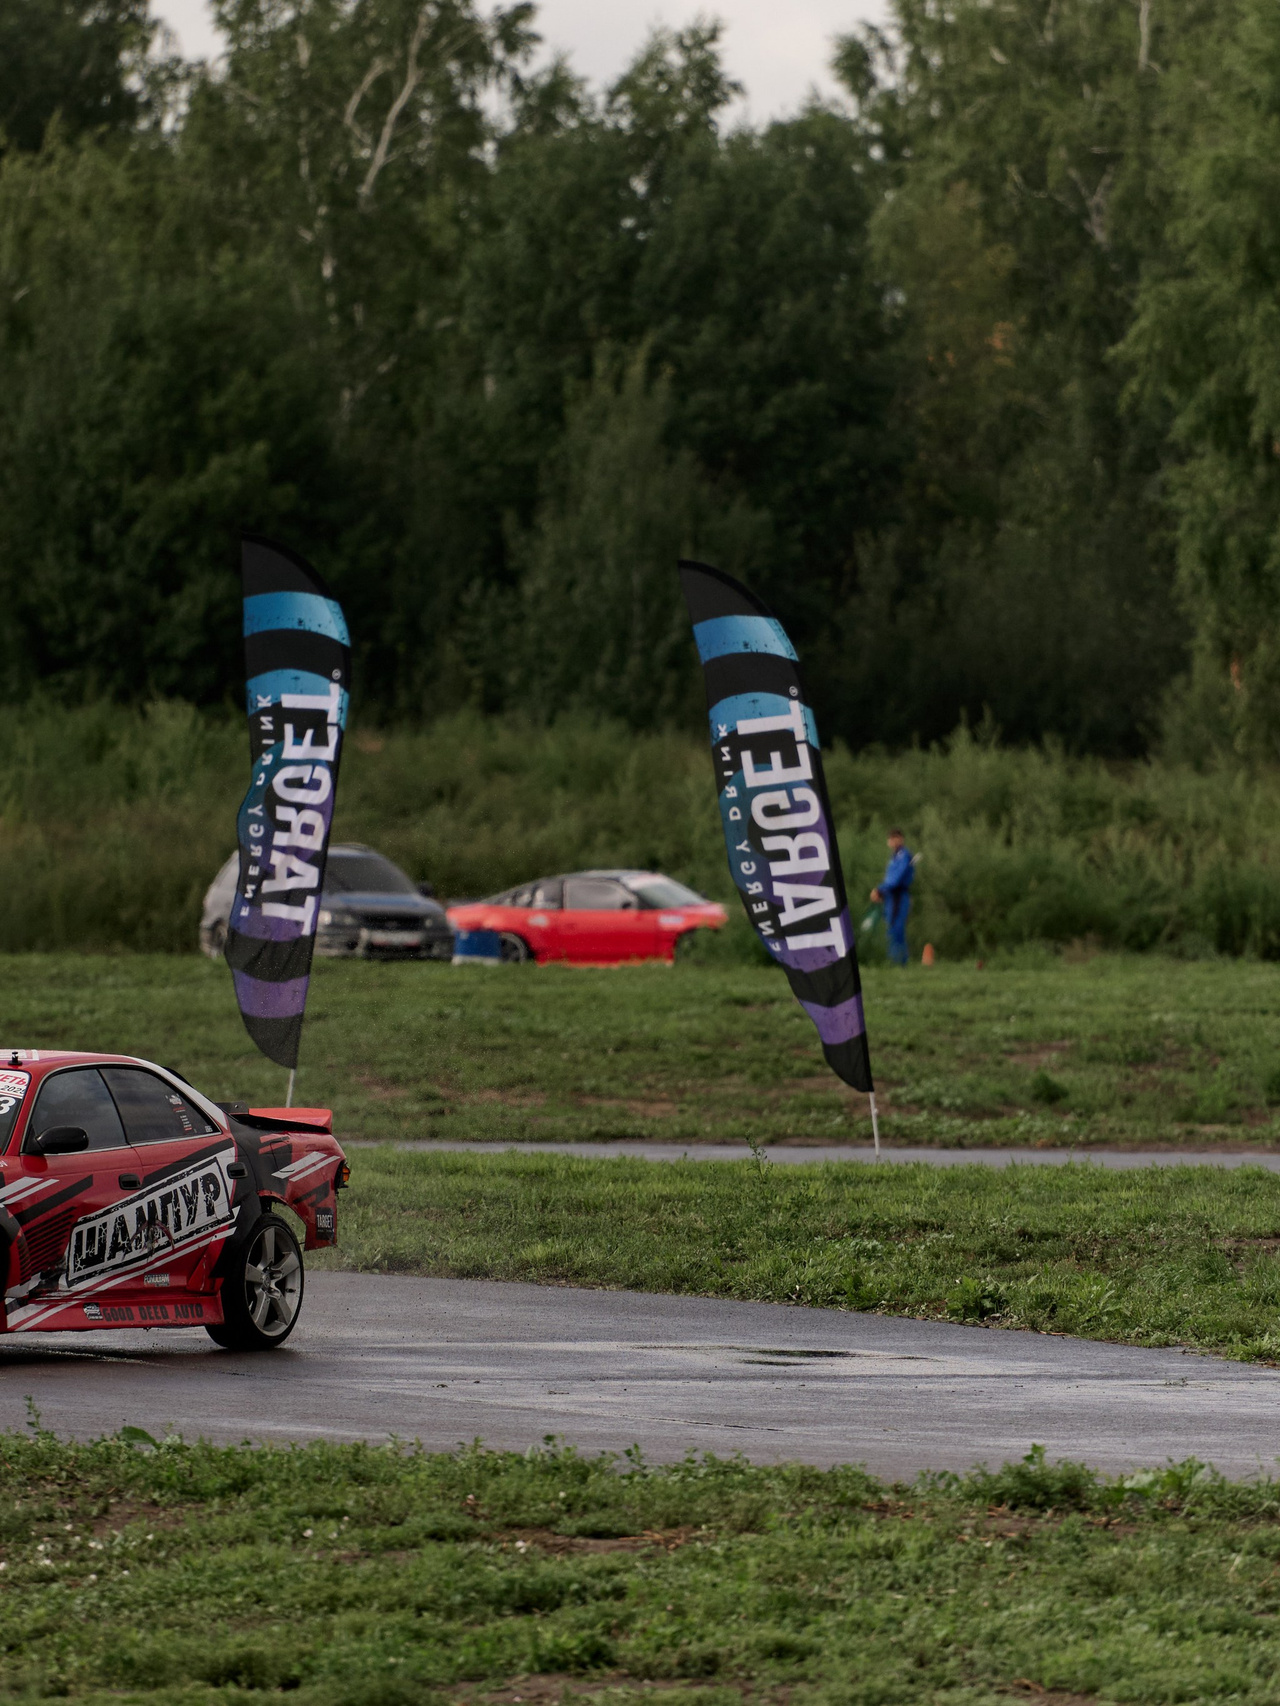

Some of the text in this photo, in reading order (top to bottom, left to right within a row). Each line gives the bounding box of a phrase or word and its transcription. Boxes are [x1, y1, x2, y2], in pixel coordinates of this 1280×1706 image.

[73, 1172, 221, 1274] ШАМПУР
[102, 1306, 134, 1322] GOOD
[174, 1303, 204, 1319] AUTO
